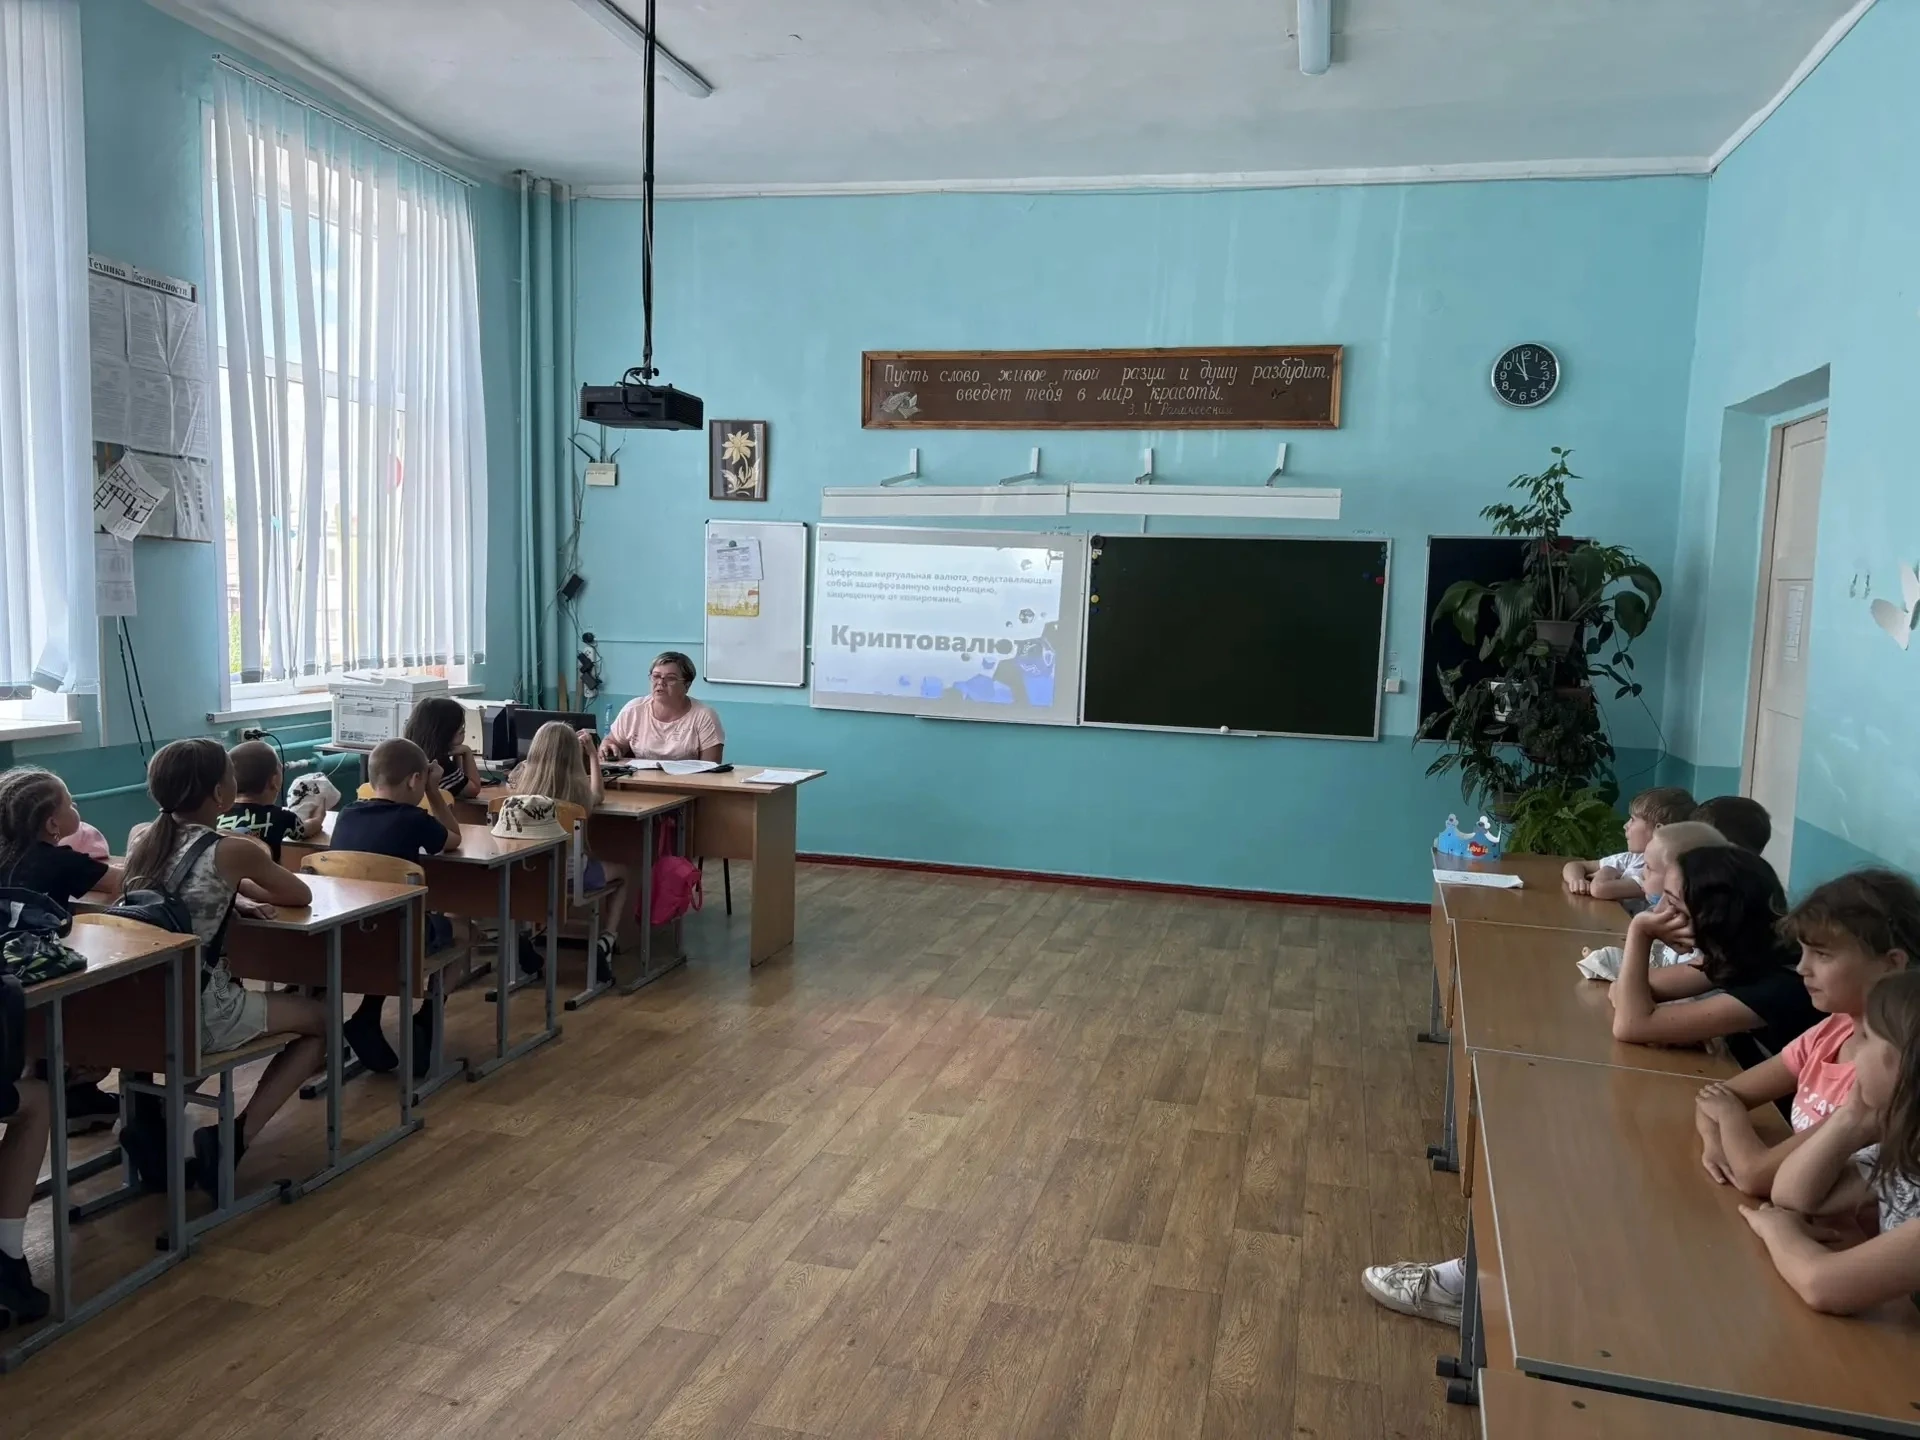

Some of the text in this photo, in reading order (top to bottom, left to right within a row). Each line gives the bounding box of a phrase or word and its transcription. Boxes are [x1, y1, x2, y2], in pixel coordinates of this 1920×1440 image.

[88, 256, 126, 277] Техника
[1512, 352, 1519, 363] 11
[1503, 361, 1513, 370] 10
[1540, 360, 1548, 370] 2
[884, 364, 929, 387] Пусть
[939, 369, 980, 383] слово
[998, 368, 1047, 382] живое
[1063, 367, 1100, 381] твой
[1121, 366, 1166, 387] разум
[1179, 367, 1189, 381] и
[1200, 358, 1238, 386] душу
[1500, 371, 1508, 380] 9
[1542, 370, 1550, 380] 3
[1501, 381, 1509, 390] 8
[1538, 381, 1547, 389] 4
[956, 380, 1225, 404] введет тебя в мир красоты.
[1509, 388, 1517, 398] 7
[1519, 391, 1527, 400] 6
[1530, 388, 1538, 398] 5
[826, 567, 873, 579] Цифровая
[875, 570, 932, 580] виртуальная
[826, 579, 853, 588] собой
[831, 624, 1040, 656] Криптовалют
